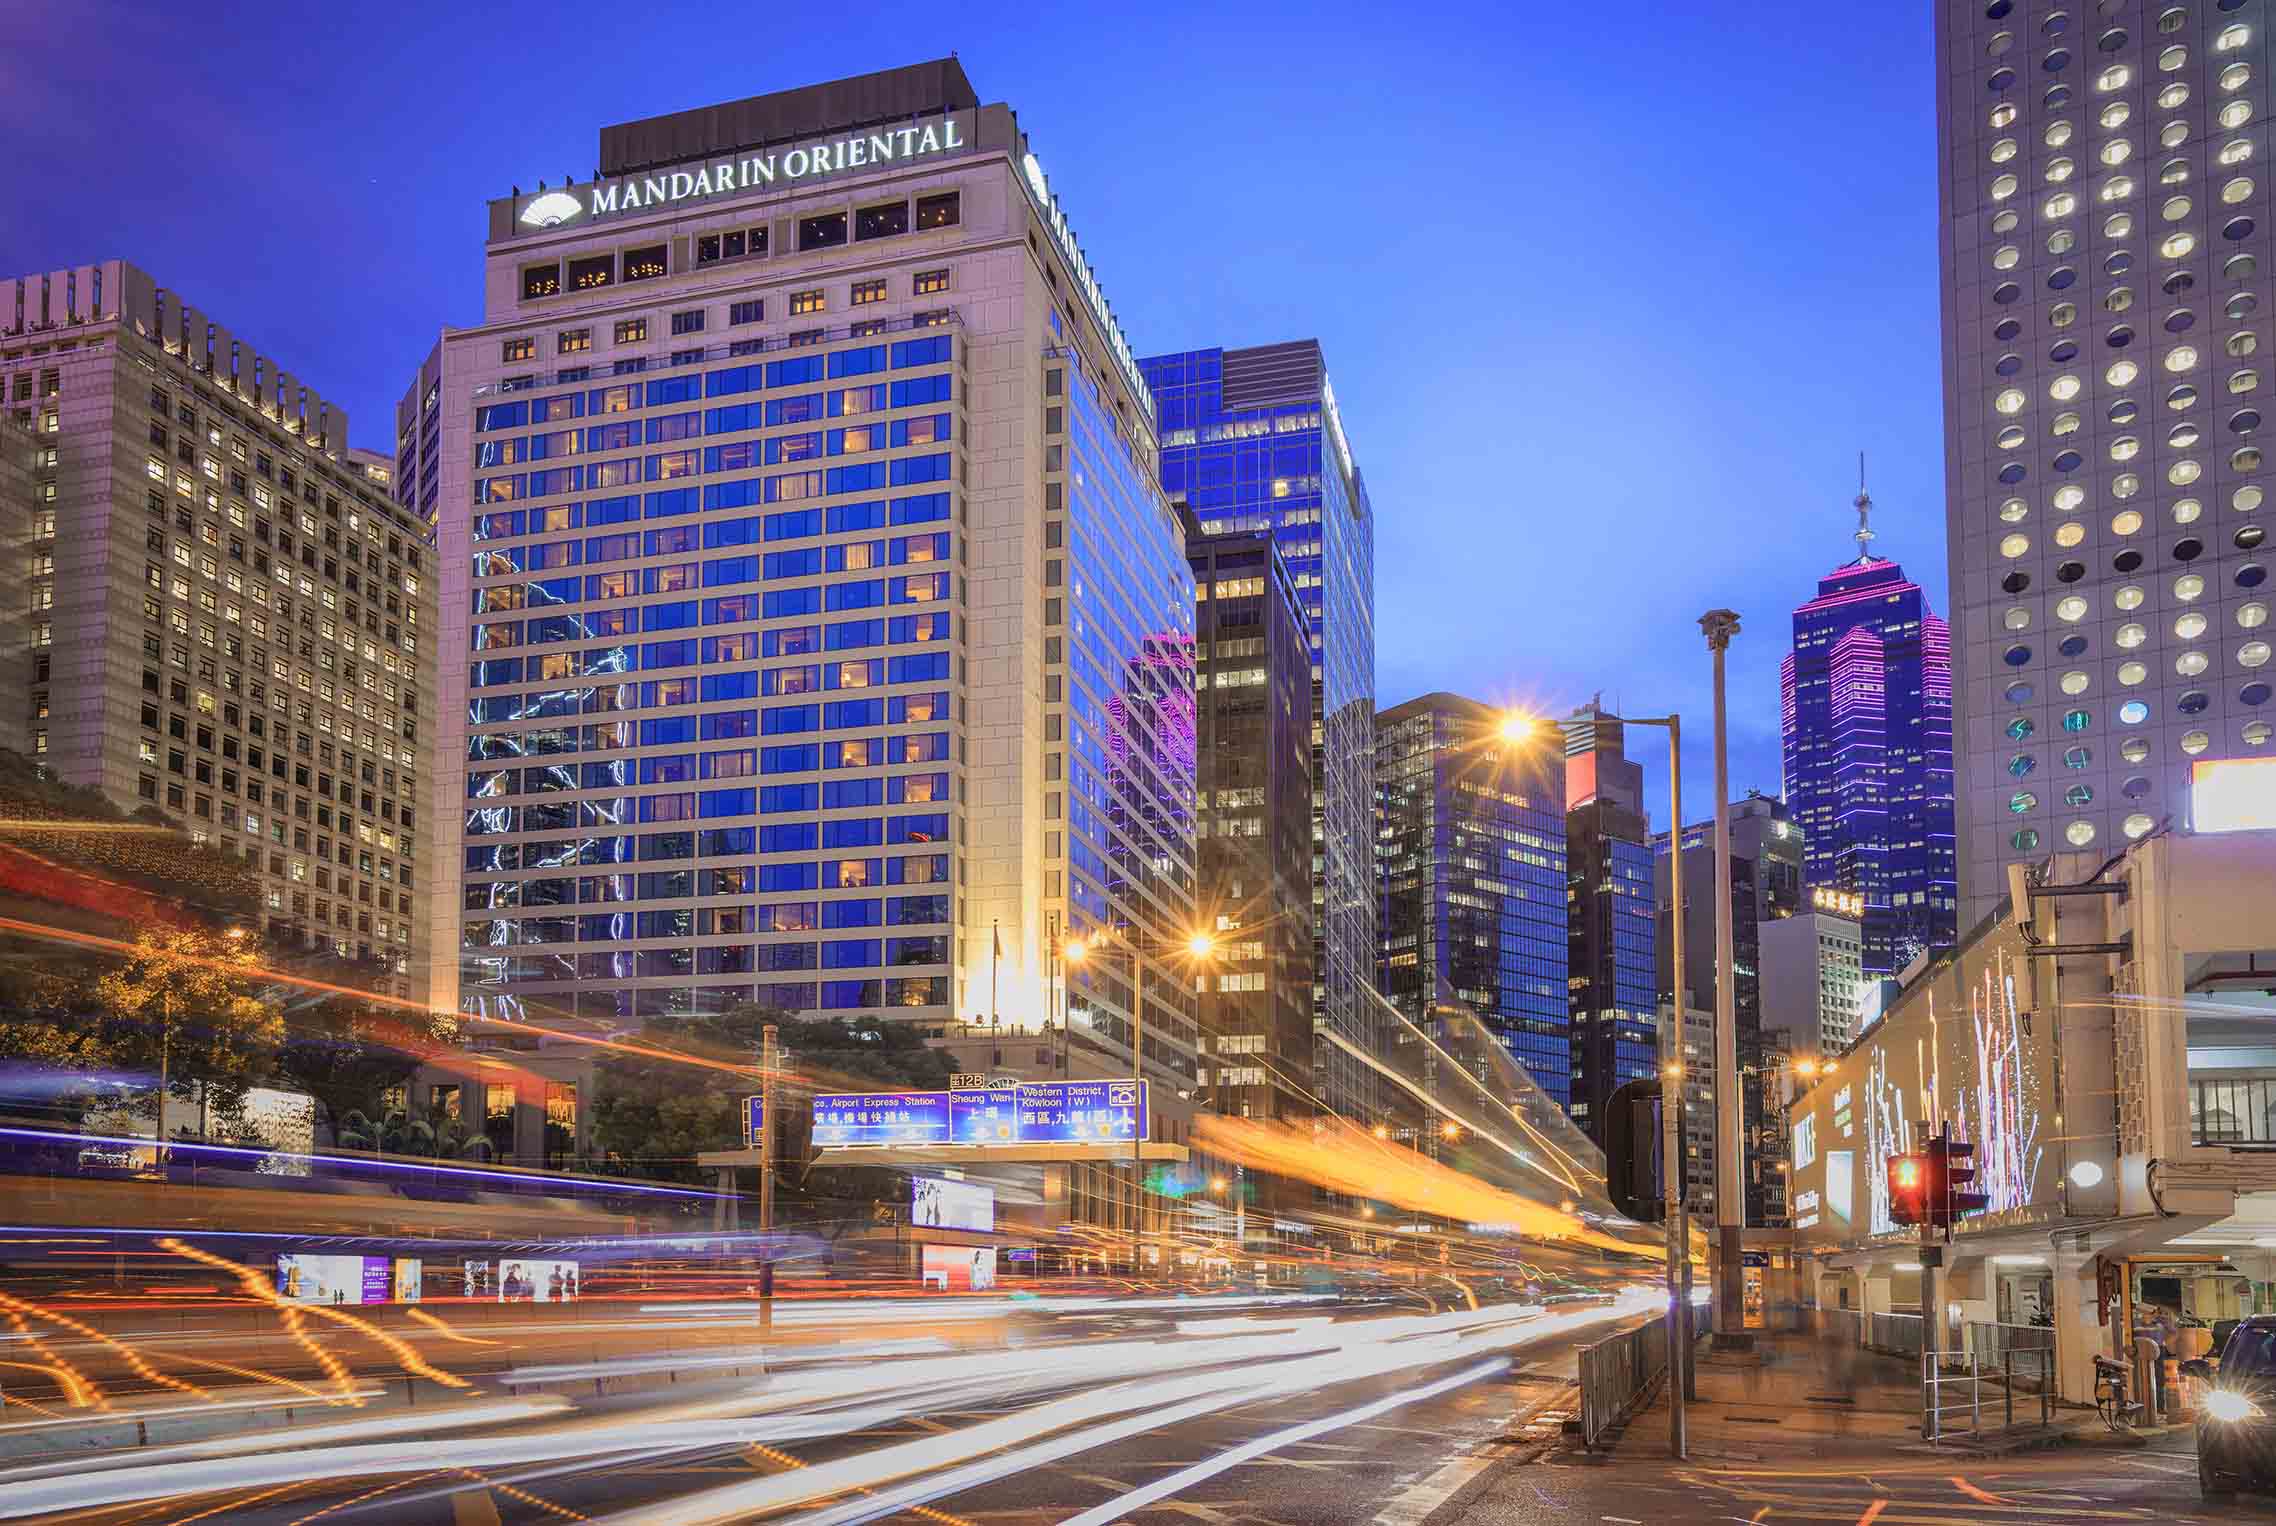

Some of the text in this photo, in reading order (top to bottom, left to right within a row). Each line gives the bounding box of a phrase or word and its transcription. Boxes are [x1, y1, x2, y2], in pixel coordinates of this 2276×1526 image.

[592, 120, 963, 215] MANDARIN ORIENTAL
[1050, 195, 1153, 420] MANDARIN ORIENTAL
[1022, 1086, 1105, 1097] Western District,
[831, 1098, 859, 1109] Airport
[864, 1097, 899, 1107] Express
[904, 1096, 936, 1106] Station
[951, 1093, 1011, 1104] Sheung Wan
[1022, 1098, 1063, 1107] Kowloon
